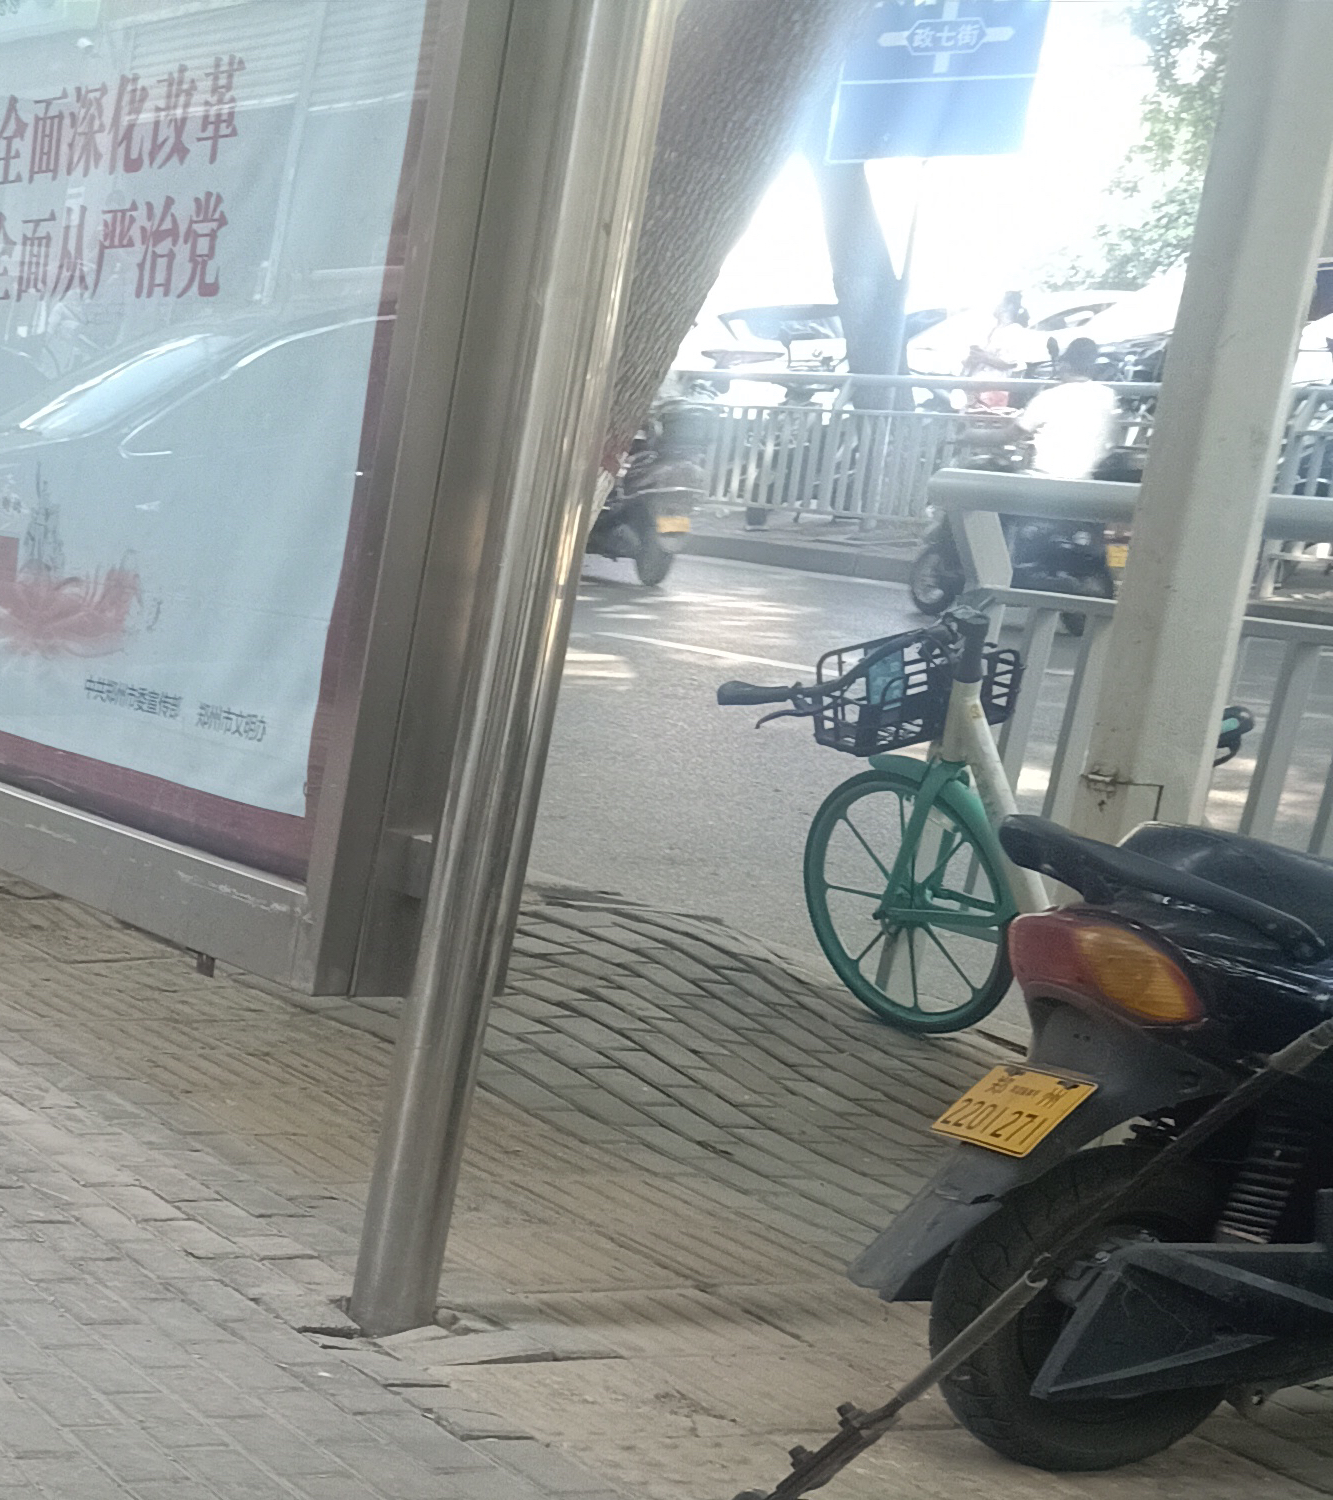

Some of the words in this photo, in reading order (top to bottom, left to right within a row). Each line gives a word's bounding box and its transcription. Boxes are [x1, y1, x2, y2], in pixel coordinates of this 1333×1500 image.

[913, 24, 980, 48] 政七街
[940, 1098, 1049, 1146] 2201271
